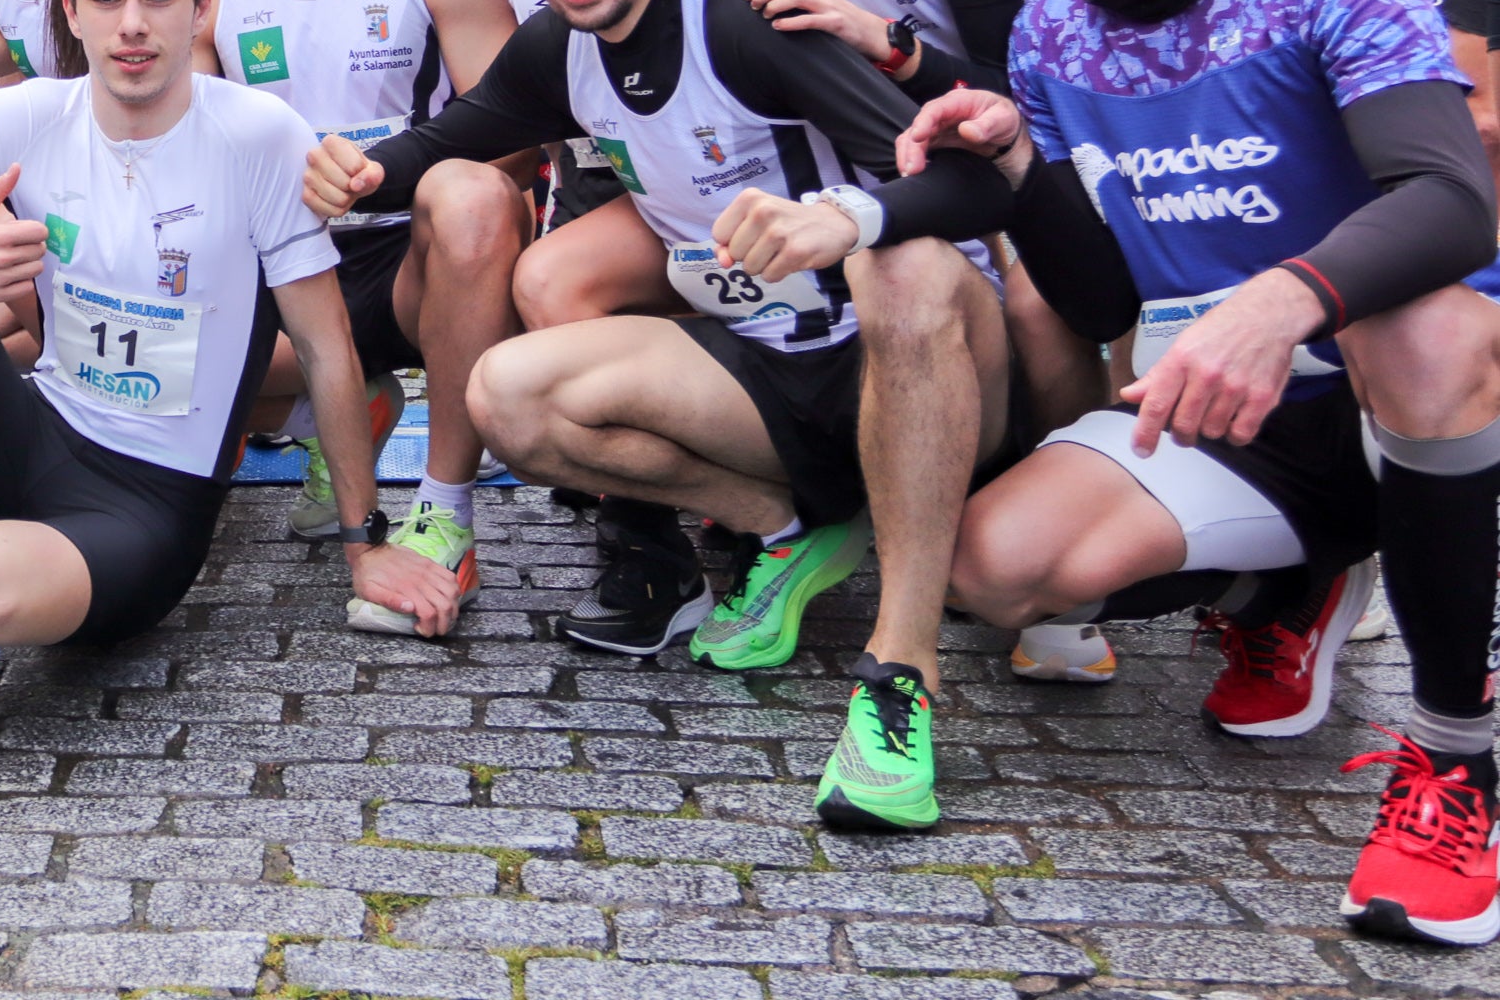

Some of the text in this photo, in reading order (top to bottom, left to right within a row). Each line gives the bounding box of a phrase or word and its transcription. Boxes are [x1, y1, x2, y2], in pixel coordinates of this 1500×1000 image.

[349, 46, 412, 60] Ayuntamiento
[350, 59, 413, 72] de Salamanca
[691, 157, 761, 187] Ayuntamiento
[699, 164, 769, 197] de Salamanca
[64, 282, 184, 321] III CARRERA SOLIDARIA
[704, 269, 764, 304] 23
[69, 297, 175, 331] Colegio Maestro Ávila
[90, 321, 138, 367] 11
[76, 361, 150, 401] HESAN
[78, 381, 149, 409] DISTRIBUCIÓN
